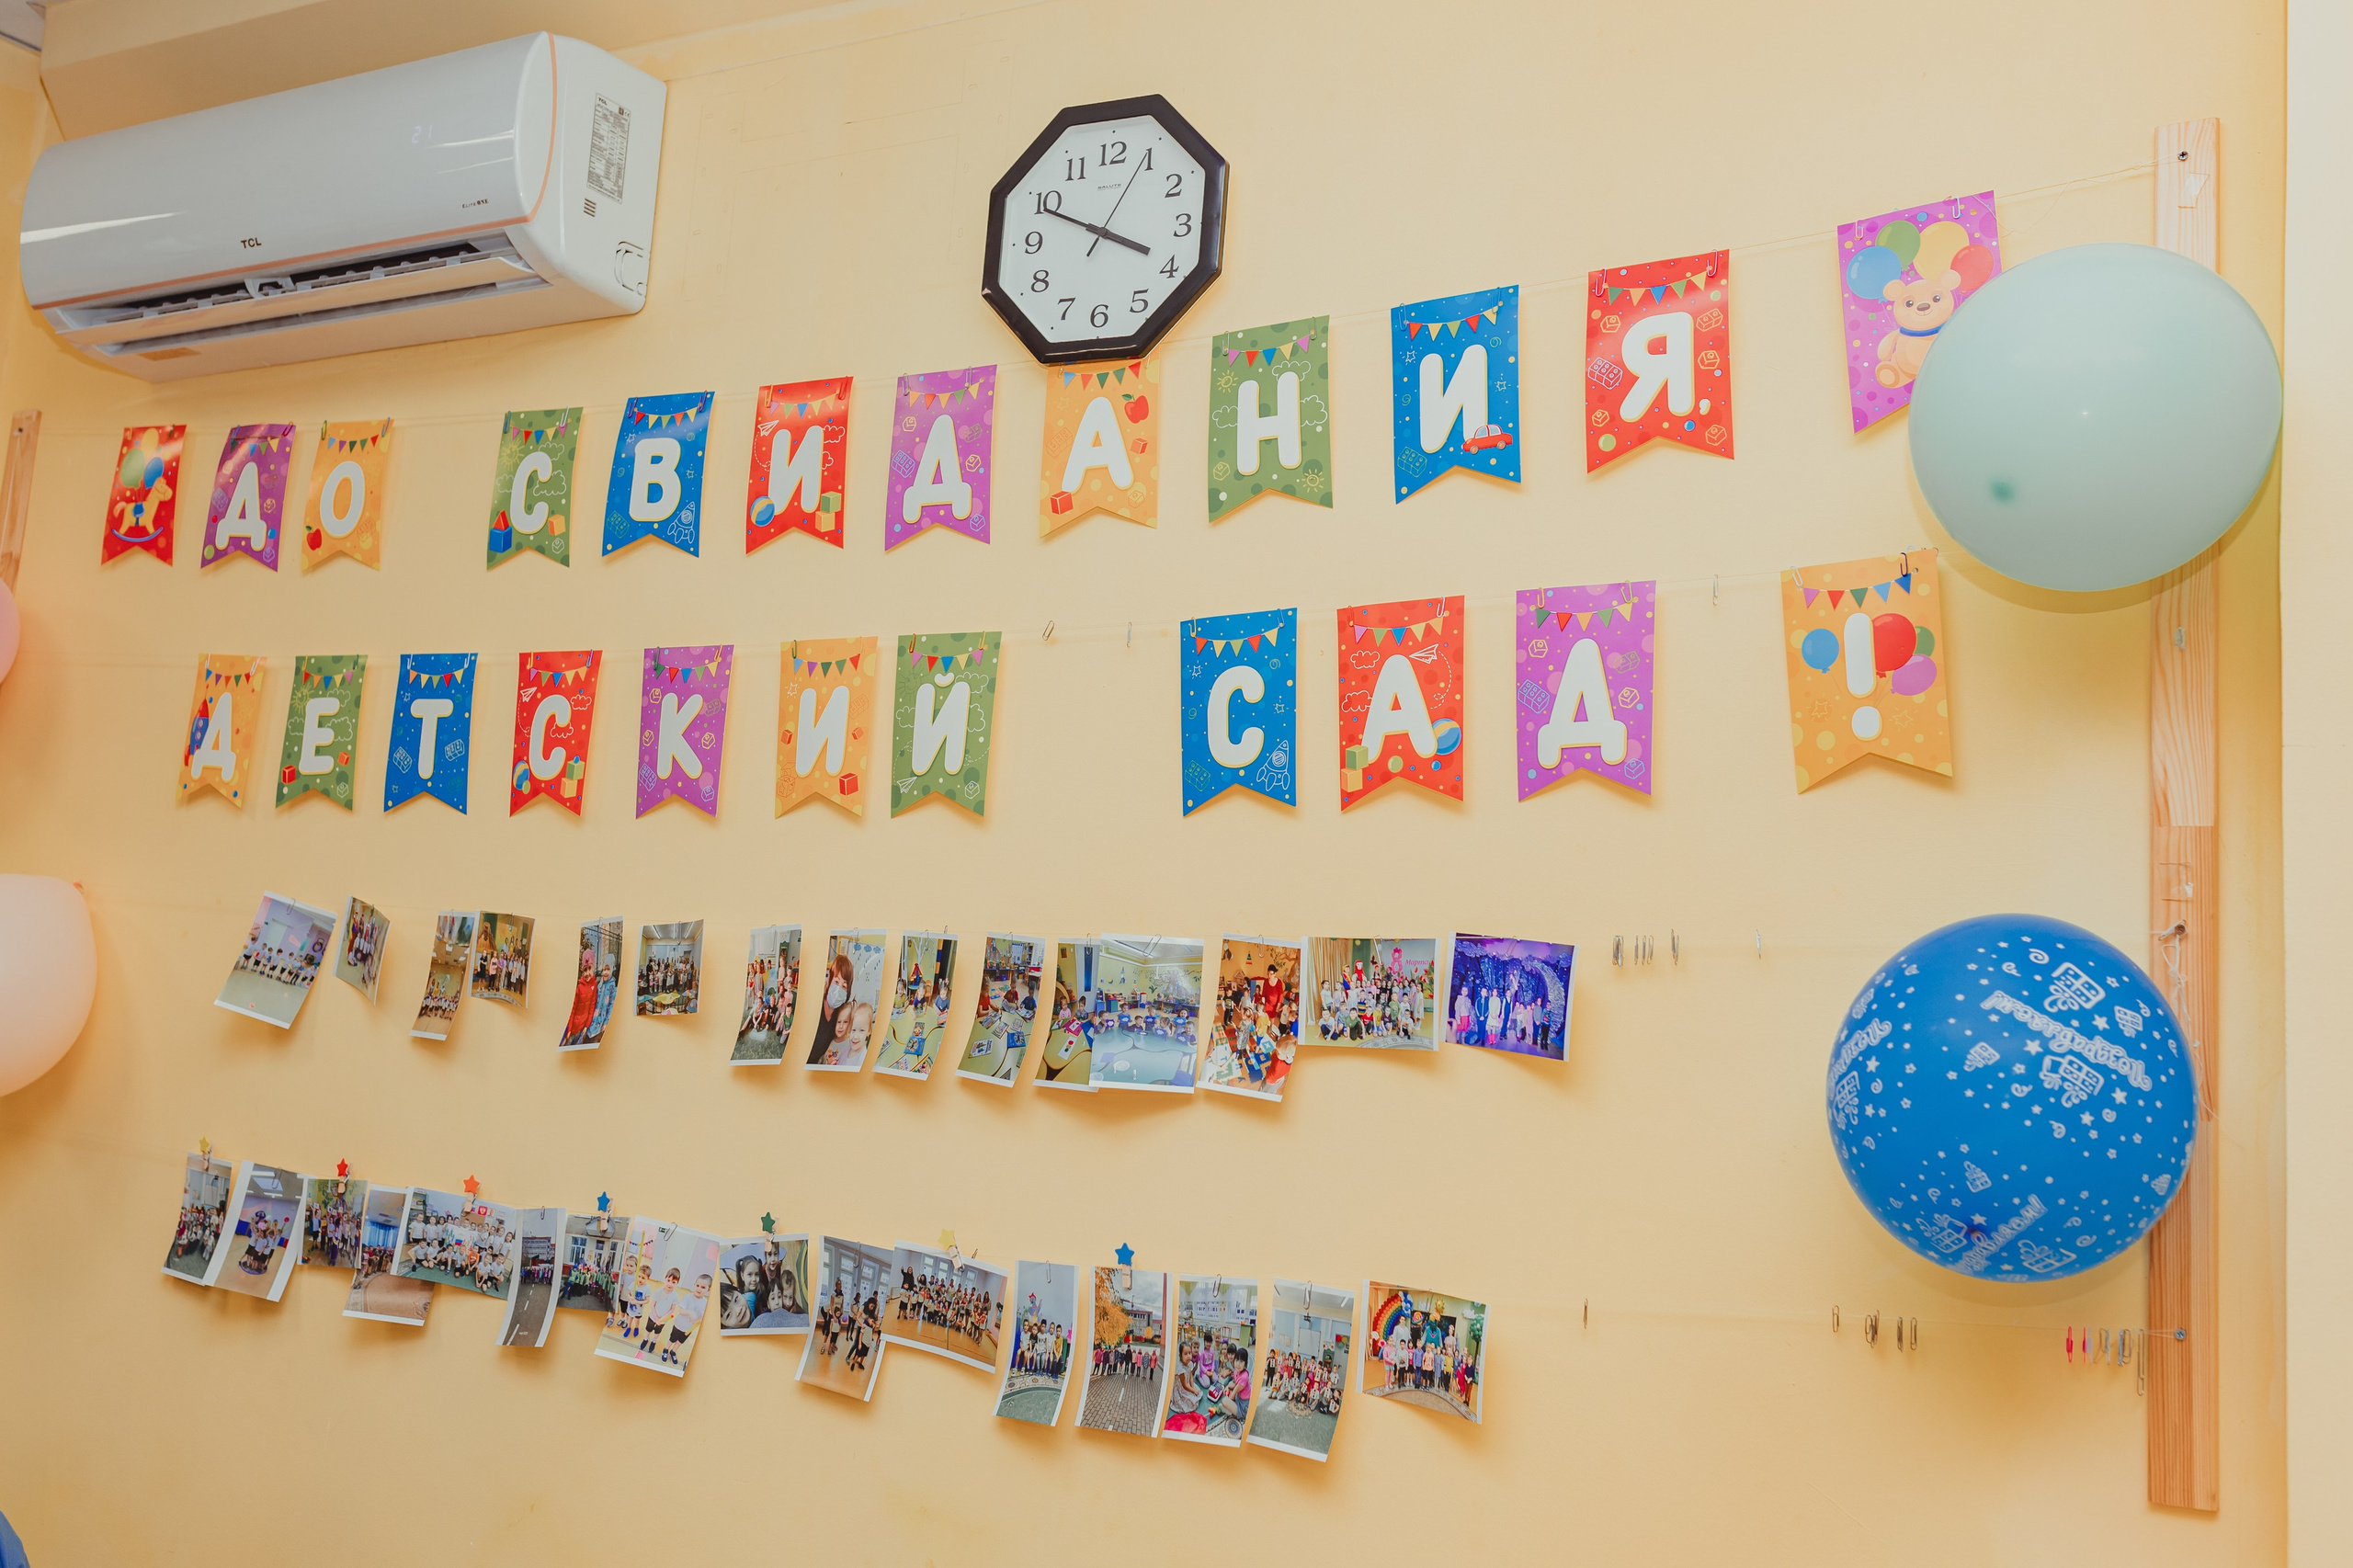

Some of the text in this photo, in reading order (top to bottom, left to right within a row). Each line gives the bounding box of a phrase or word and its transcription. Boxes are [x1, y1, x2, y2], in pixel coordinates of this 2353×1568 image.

[412, 124, 433, 144] 21
[1098, 141, 1127, 166] 12
[1144, 147, 1154, 171] 1
[1064, 156, 1086, 181] 11
[1165, 174, 1183, 198] 2
[1034, 190, 1062, 215] 10
[1173, 212, 1192, 237] 3
[240, 237, 262, 249] TCL
[1024, 231, 1043, 254] 9
[1159, 255, 1179, 278] 4
[1030, 269, 1050, 293] 8
[1057, 297, 1075, 321] 7
[1130, 289, 1149, 313] 5
[1090, 304, 1108, 328] 6
[215, 460, 366, 551] ДО
[190, 672, 972, 780] ДЕТСКИЙ
[1980, 990, 2153, 1092] Поздравляем!
